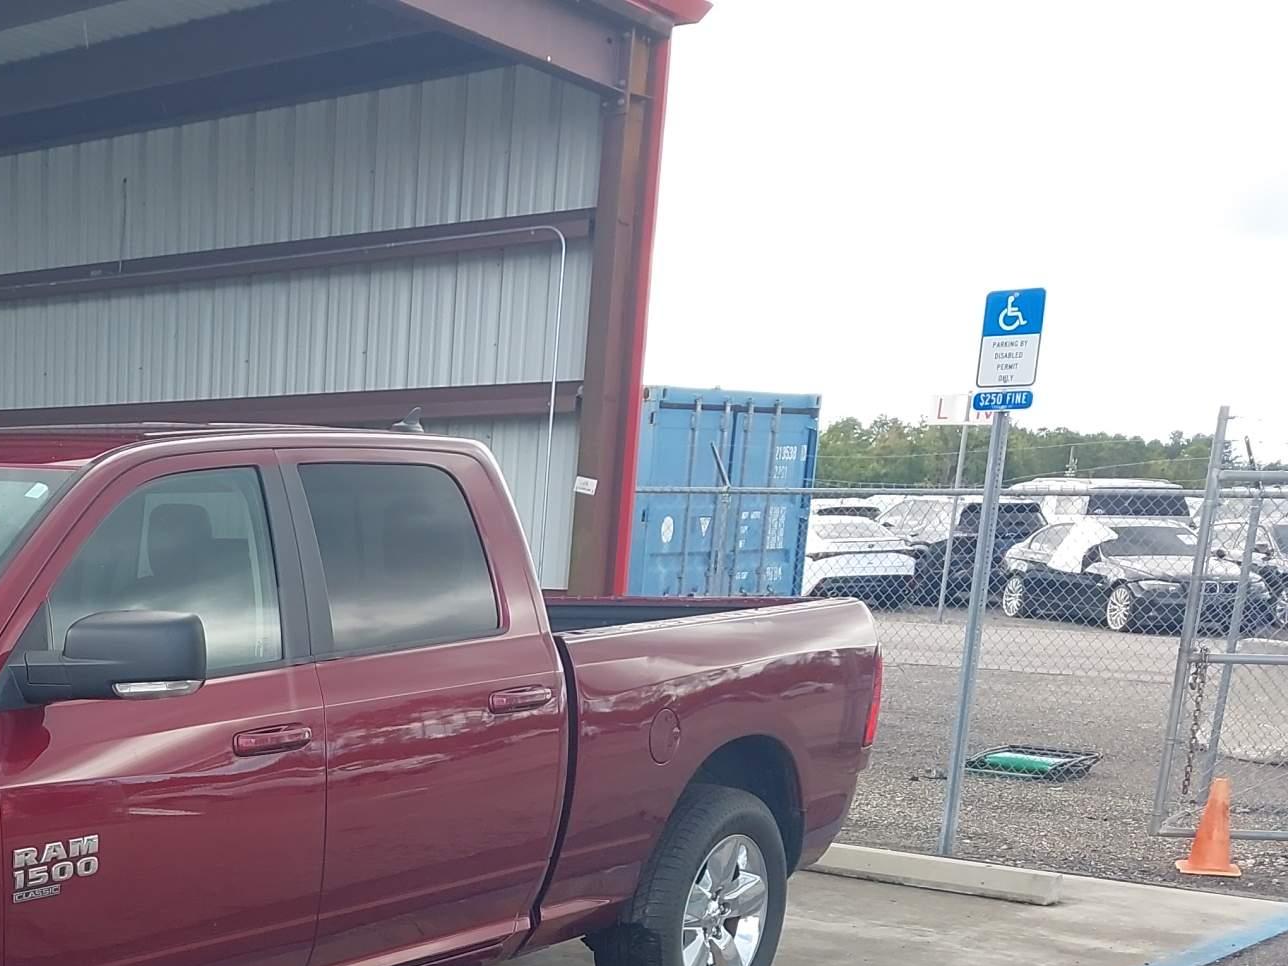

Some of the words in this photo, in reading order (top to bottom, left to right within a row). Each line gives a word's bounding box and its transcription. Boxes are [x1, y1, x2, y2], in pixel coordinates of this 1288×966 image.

[992, 340, 1019, 348] PARKING
[979, 393, 1002, 407] $250
[1006, 392, 1028, 404] FINE
[13, 834, 99, 868] RAM
[13, 856, 99, 889] 1500
[14, 885, 60, 902] CLASSIC
